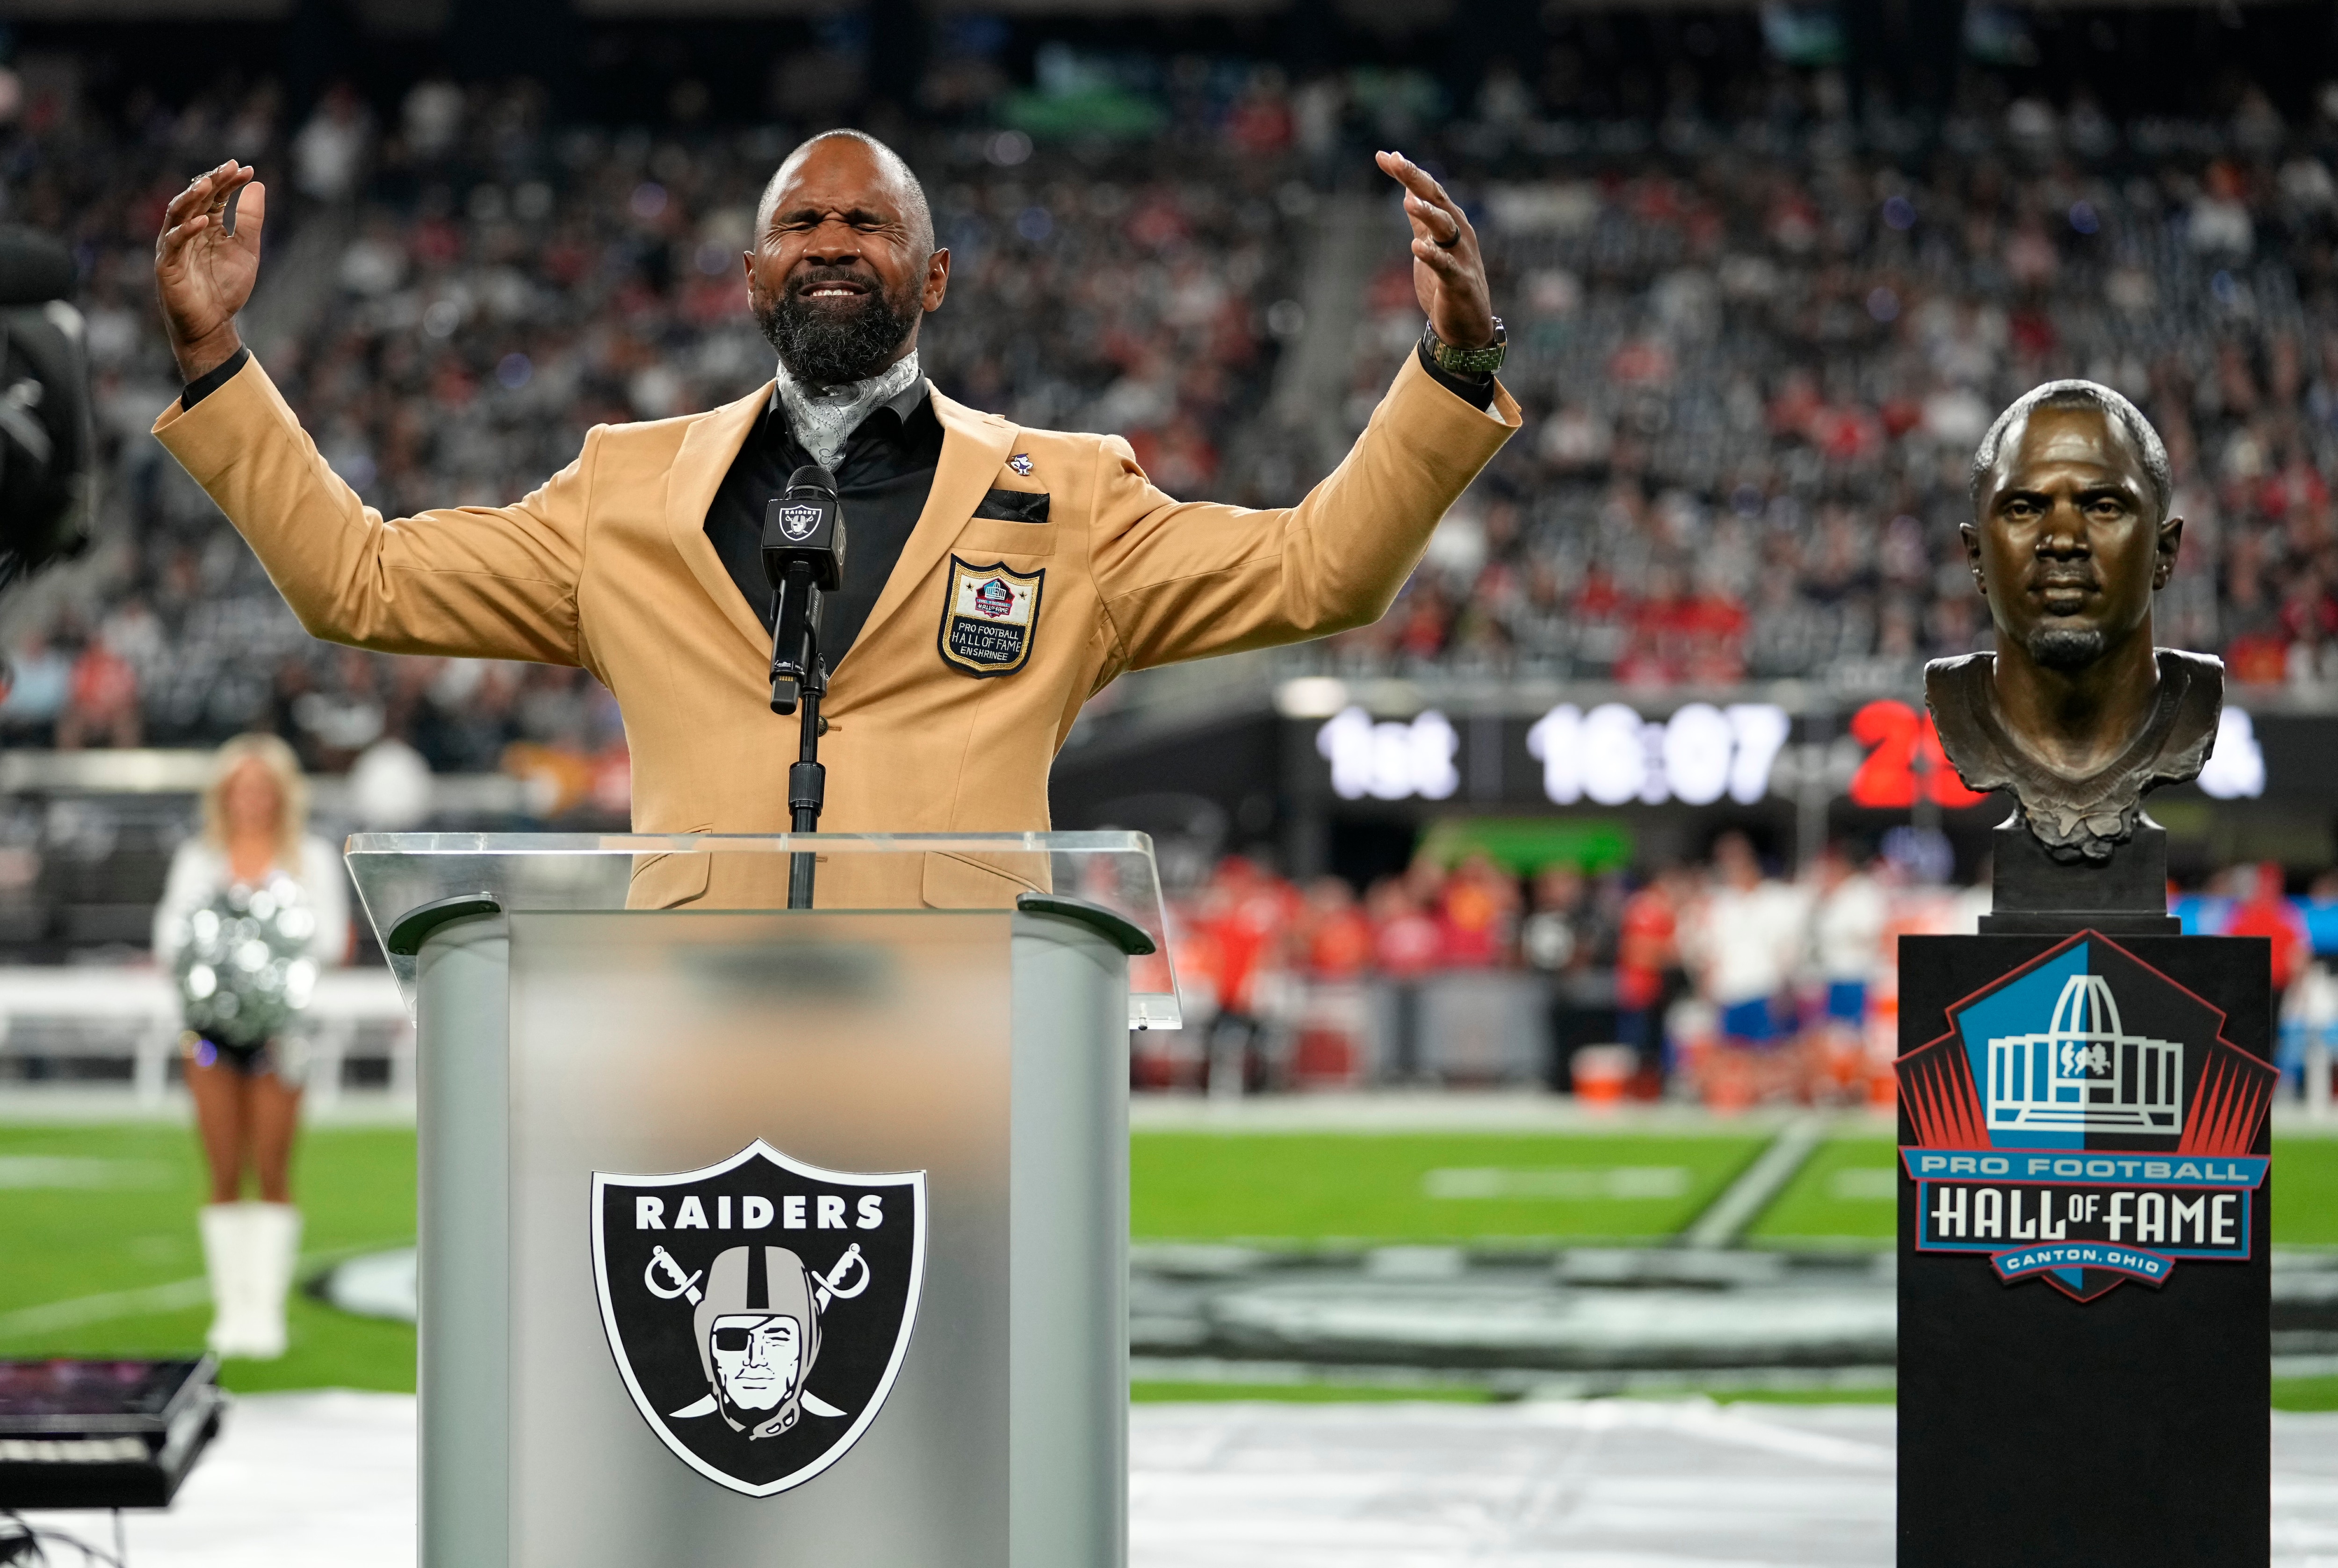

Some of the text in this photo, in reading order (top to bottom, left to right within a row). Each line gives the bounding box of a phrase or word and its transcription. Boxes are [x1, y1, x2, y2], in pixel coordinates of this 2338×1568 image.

[952, 631, 1022, 652] HALL OF FAME
[959, 622, 1019, 640] PRO FOOTBALL
[960, 646, 1009, 661] ENSHRINEE
[1921, 1156, 2249, 1181] PRO FOOTBALL
[635, 1194, 883, 1230] RAIDERS
[1931, 1187, 2237, 1244] HALL OF FAME
[2006, 1249, 2159, 1273] CANTON, OHIO
